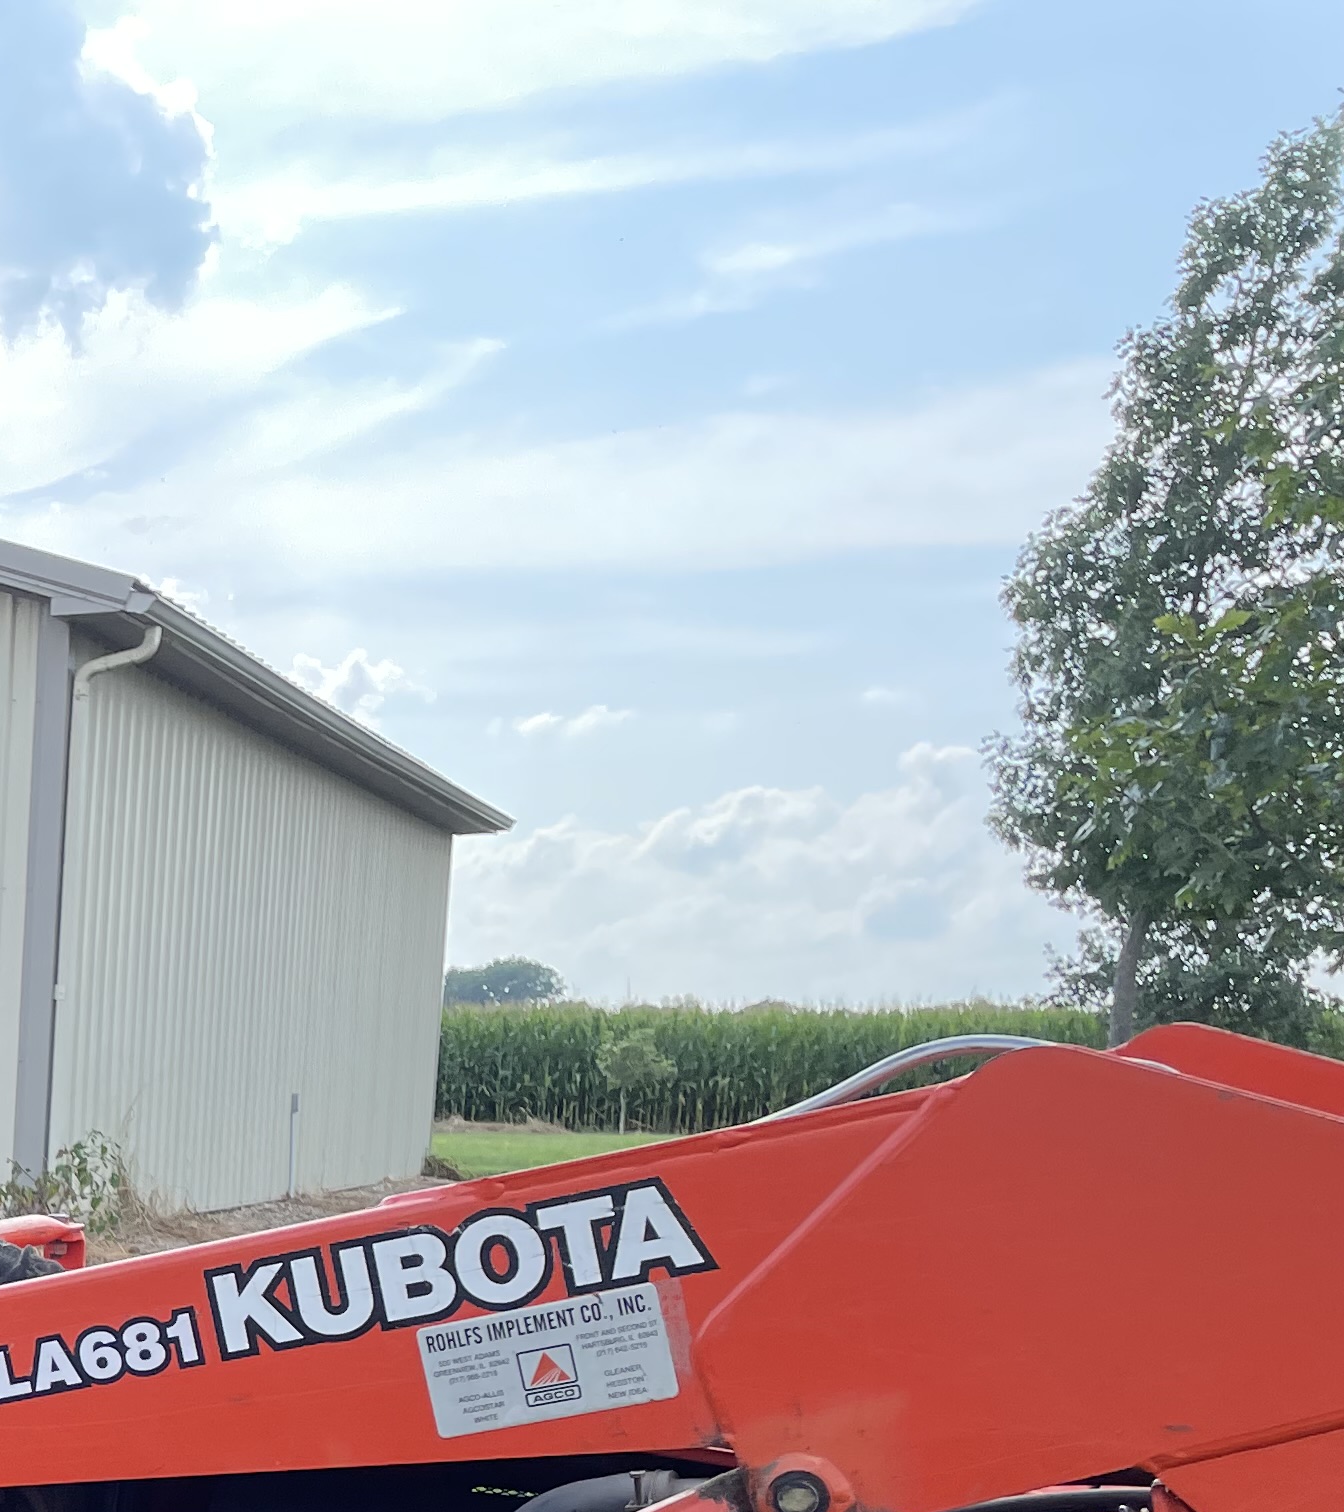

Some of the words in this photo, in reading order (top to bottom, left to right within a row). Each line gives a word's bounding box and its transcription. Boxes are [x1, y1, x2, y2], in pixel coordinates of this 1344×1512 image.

[209, 1184, 708, 1354] KUBOTA
[425, 1326, 483, 1354] ROHLFS
[487, 1307, 576, 1342] IMPLEMENT
[617, 1293, 653, 1317] INC.
[601, 1328, 616, 1336] AND
[617, 1322, 647, 1334] SECOND
[474, 1349, 501, 1360] ADAMS
[604, 1364, 642, 1377] GLEANER
[532, 1387, 576, 1404] AGCO
[608, 1390, 627, 1399] NEW
[473, 1413, 499, 1423] WHITE
